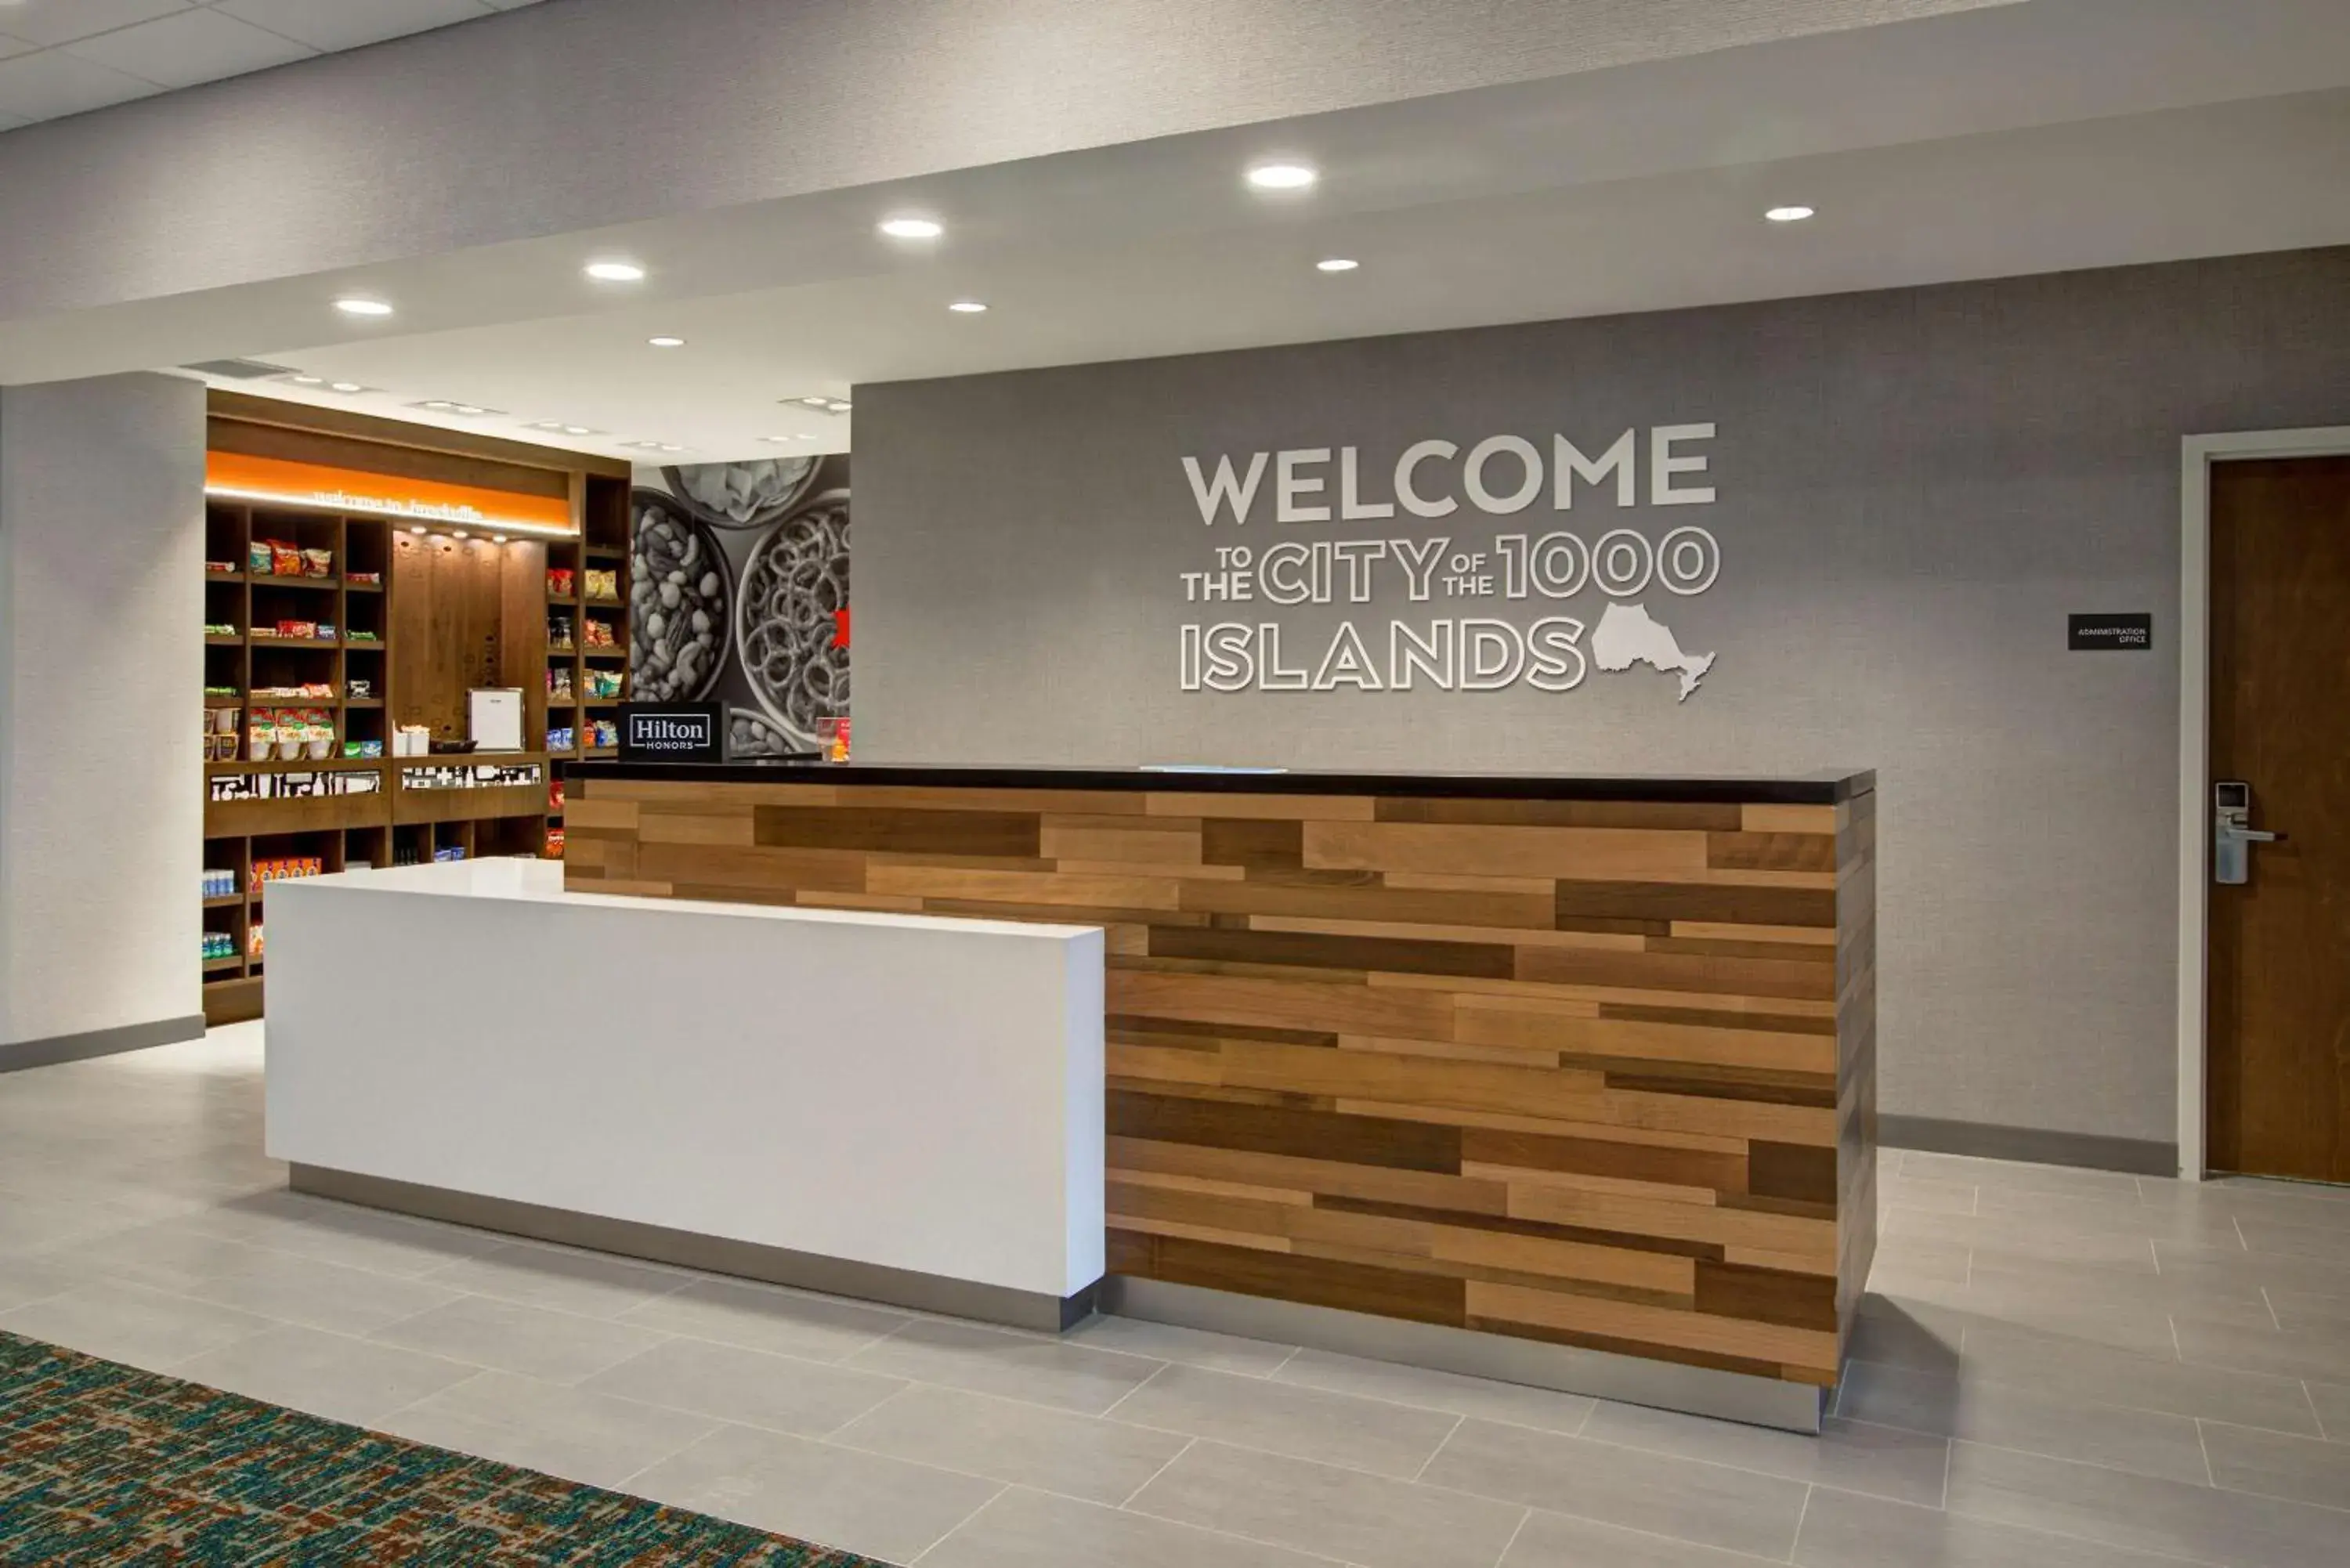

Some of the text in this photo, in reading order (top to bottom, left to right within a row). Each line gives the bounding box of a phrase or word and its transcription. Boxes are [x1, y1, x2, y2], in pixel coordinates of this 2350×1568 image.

[1181, 422, 1716, 526] WELCOME
[1180, 526, 1720, 605] TO THE CITY OF THE 1000
[1180, 617, 1585, 691] ISLANDS
[636, 720, 703, 739] Hilton
